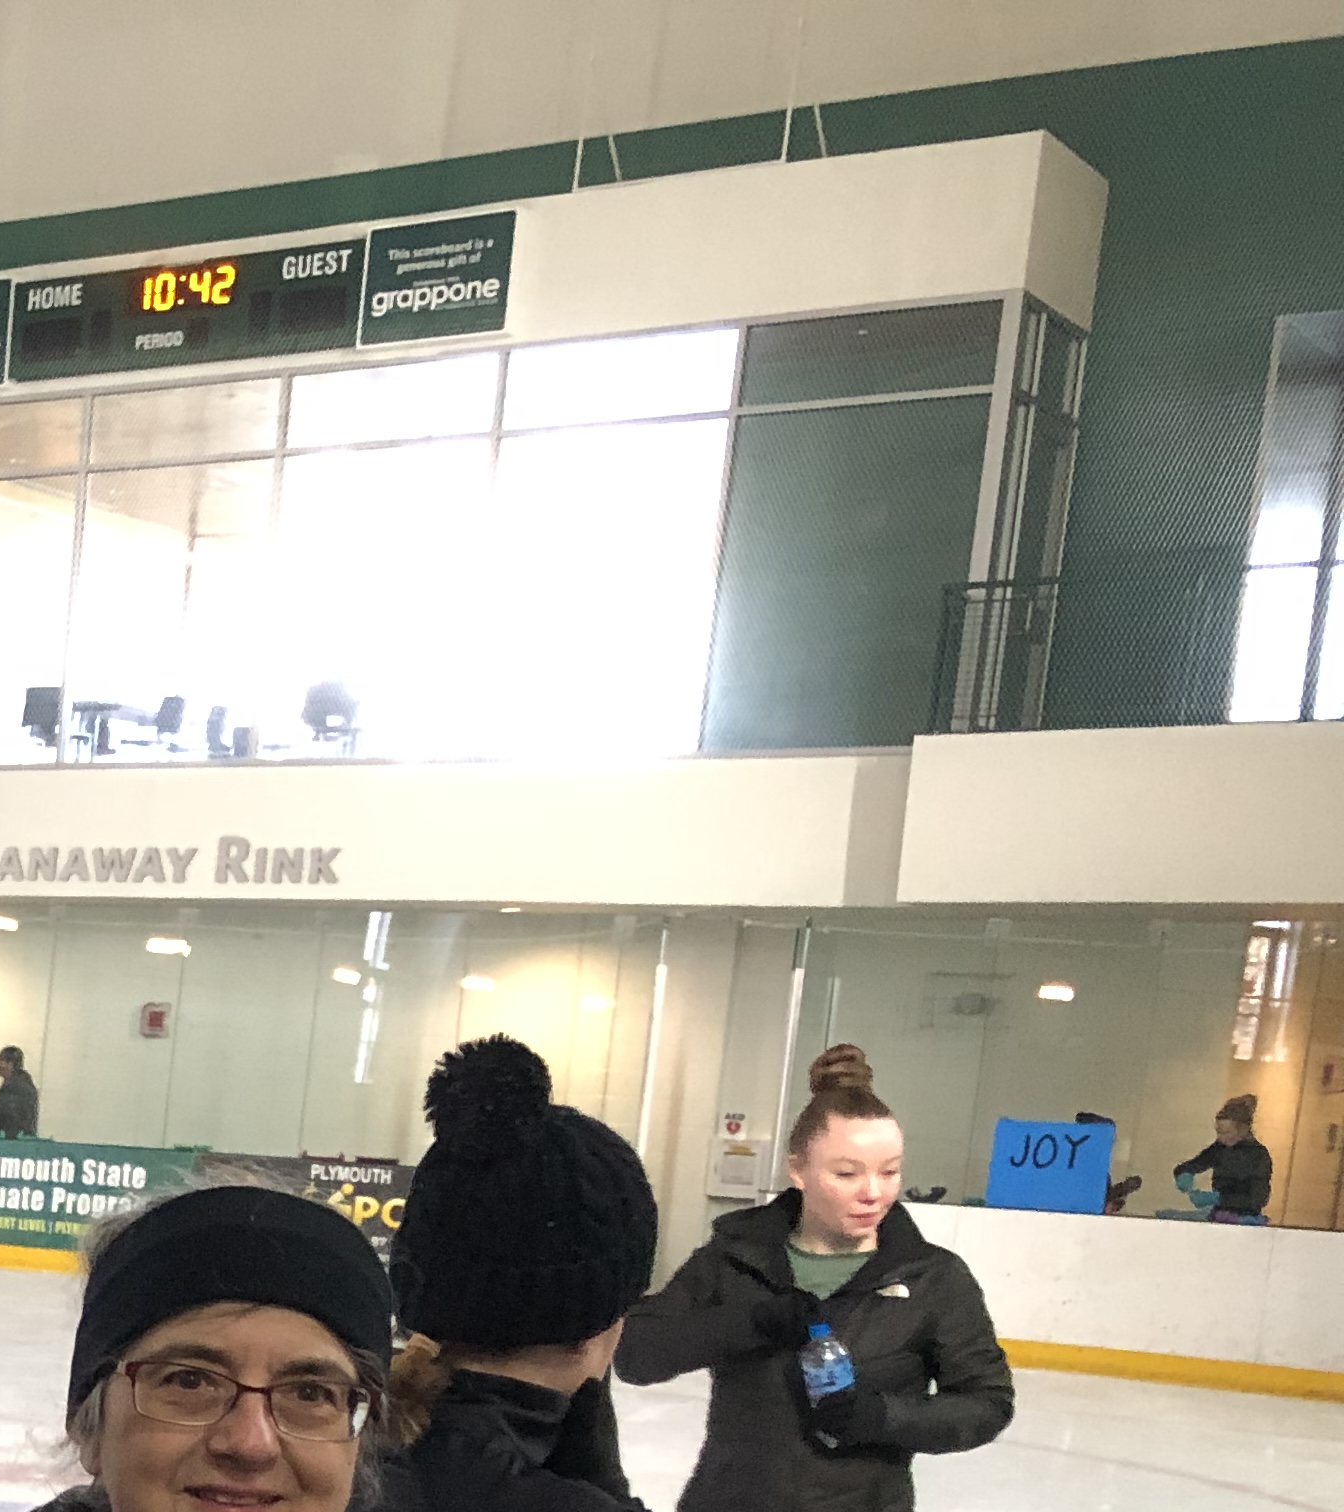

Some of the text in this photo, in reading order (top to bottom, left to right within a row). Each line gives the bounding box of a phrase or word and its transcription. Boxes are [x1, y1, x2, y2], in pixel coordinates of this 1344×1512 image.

[282, 249, 353, 281] GUEST
[28, 283, 83, 311] HOME
[141, 264, 237, 312] 10:42
[371, 278, 500, 317] grappone
[135, 331, 184, 350] PERIOD
[214, 835, 341, 885] RINK
[1009, 1133, 1091, 1169] JOY
[81, 1159, 147, 1190] State
[311, 1164, 392, 1185] PLYMOUTH
